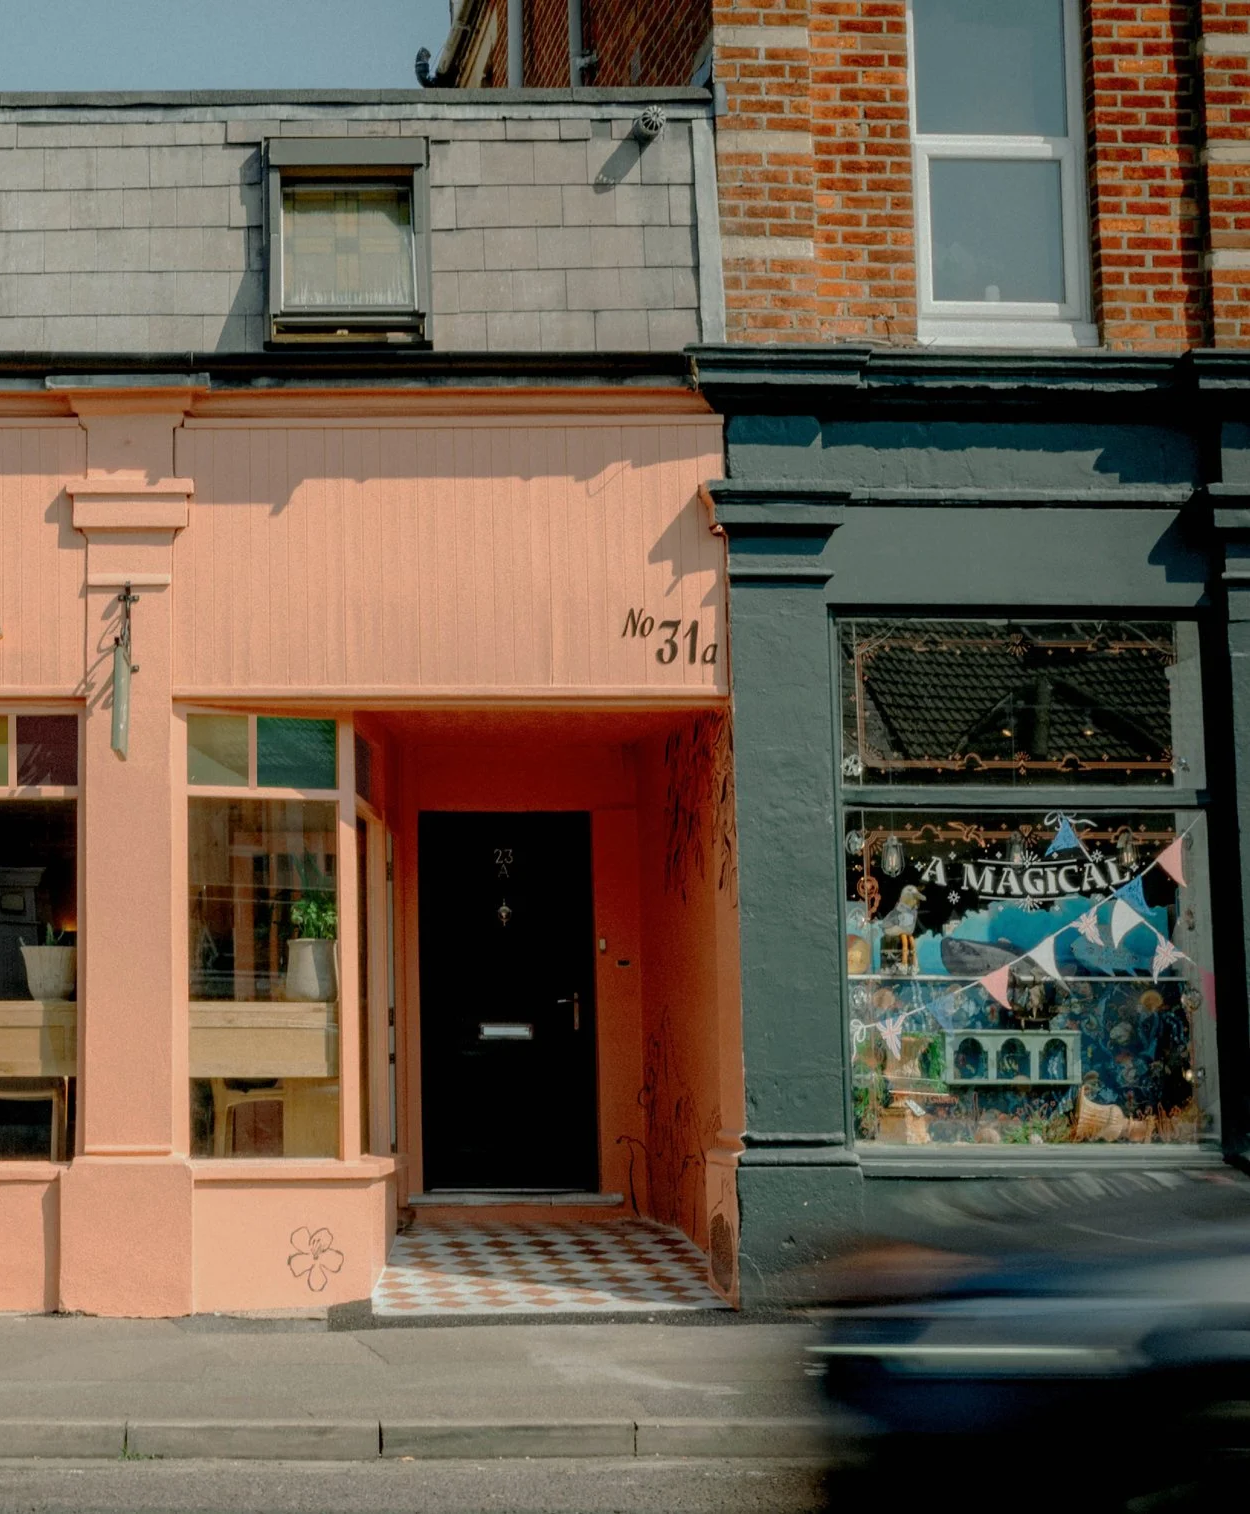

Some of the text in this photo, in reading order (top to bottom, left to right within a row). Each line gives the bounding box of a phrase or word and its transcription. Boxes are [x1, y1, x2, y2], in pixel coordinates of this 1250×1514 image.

[621, 607, 718, 665] No 31a
[493, 848, 514, 864] 23
[497, 863, 510, 878] A
[921, 856, 1131, 896] A MAGICAL
